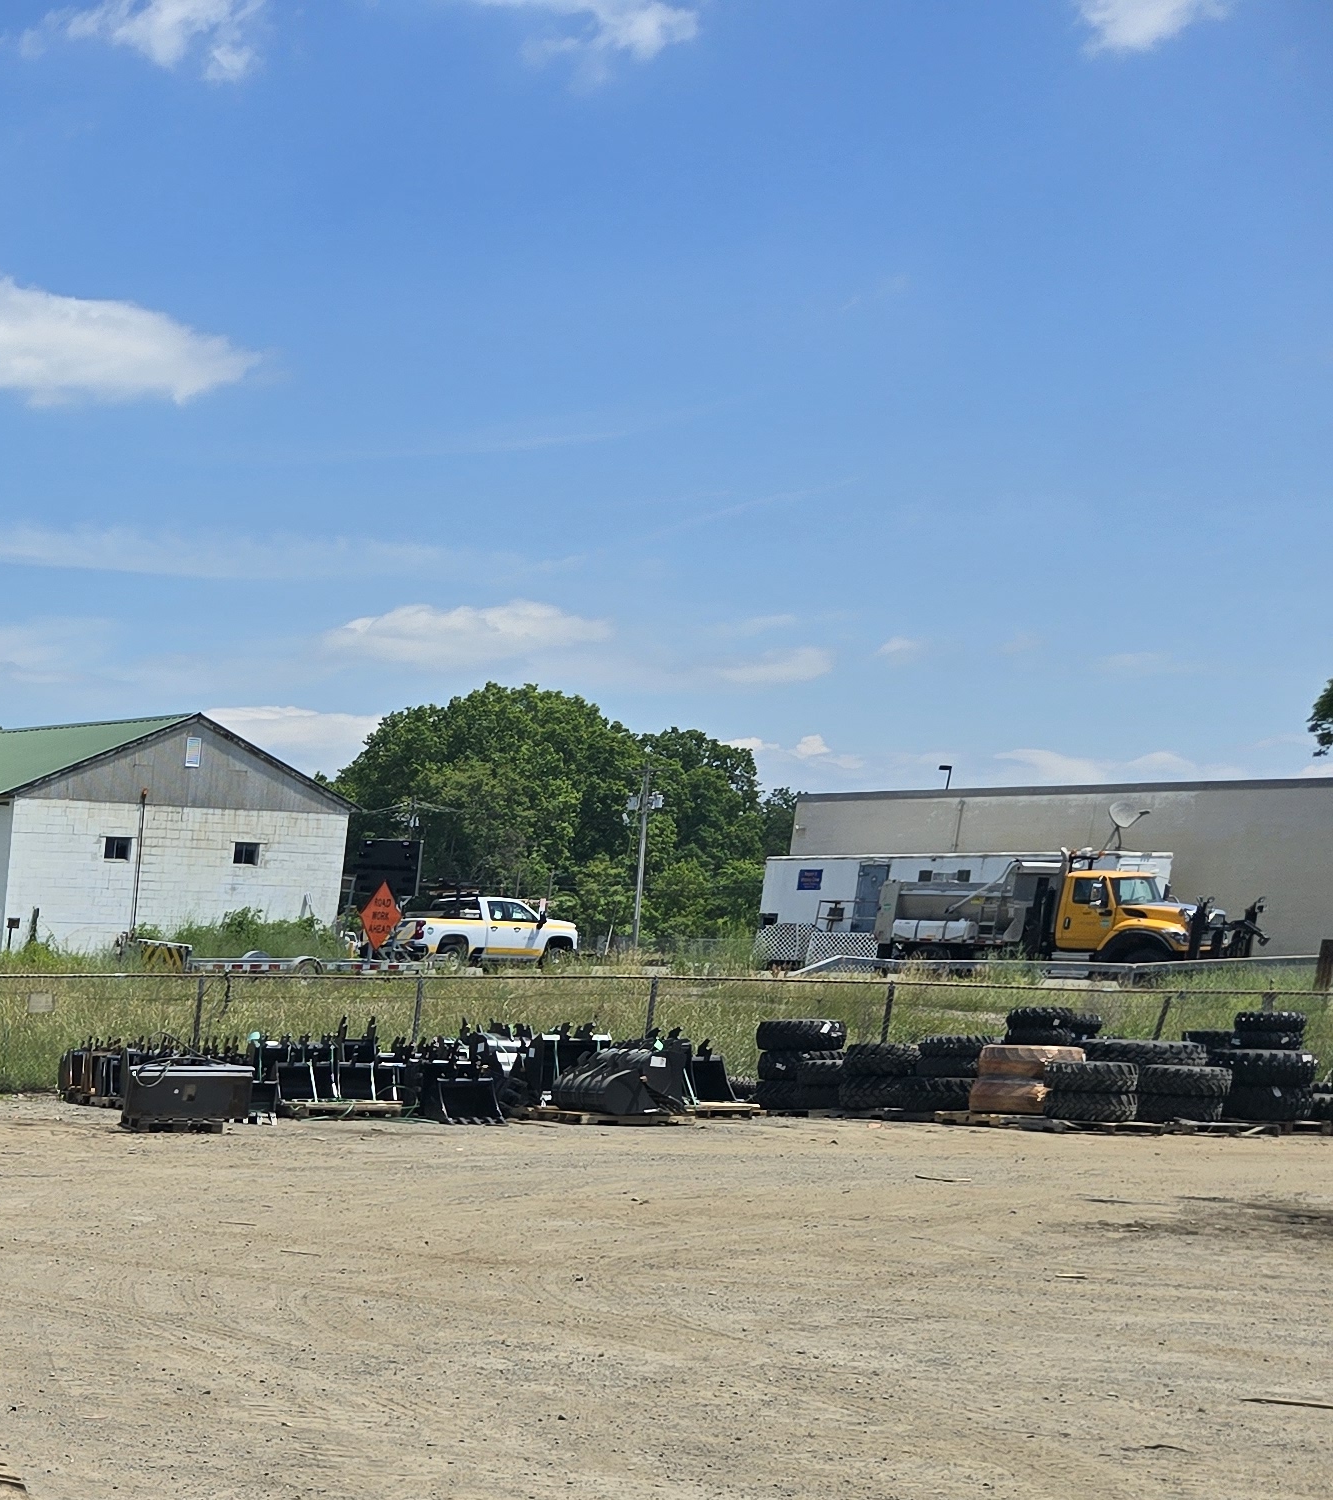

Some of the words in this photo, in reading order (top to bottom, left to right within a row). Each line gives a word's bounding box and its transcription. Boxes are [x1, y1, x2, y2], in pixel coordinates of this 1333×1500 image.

[375, 898, 391, 907] ROAD
[372, 911, 389, 920] WORK
[369, 924, 391, 933] AHEAD
